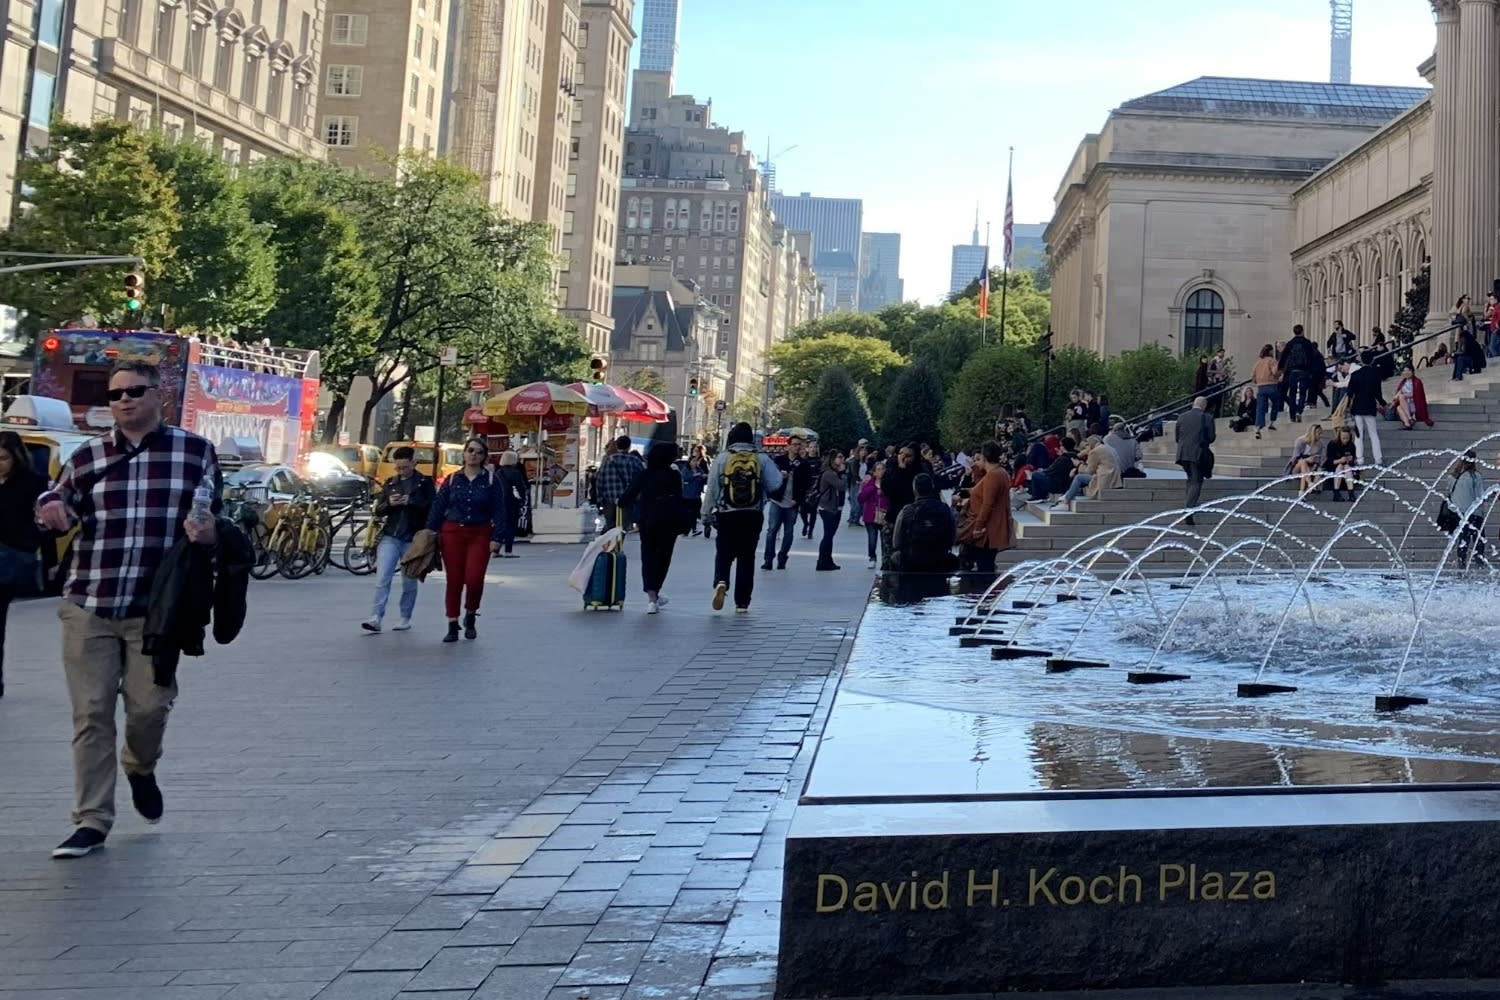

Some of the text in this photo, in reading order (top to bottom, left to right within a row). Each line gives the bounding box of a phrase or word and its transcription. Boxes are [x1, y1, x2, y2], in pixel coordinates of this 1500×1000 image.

[816, 863, 1277, 914] David H. Koch Plaza
